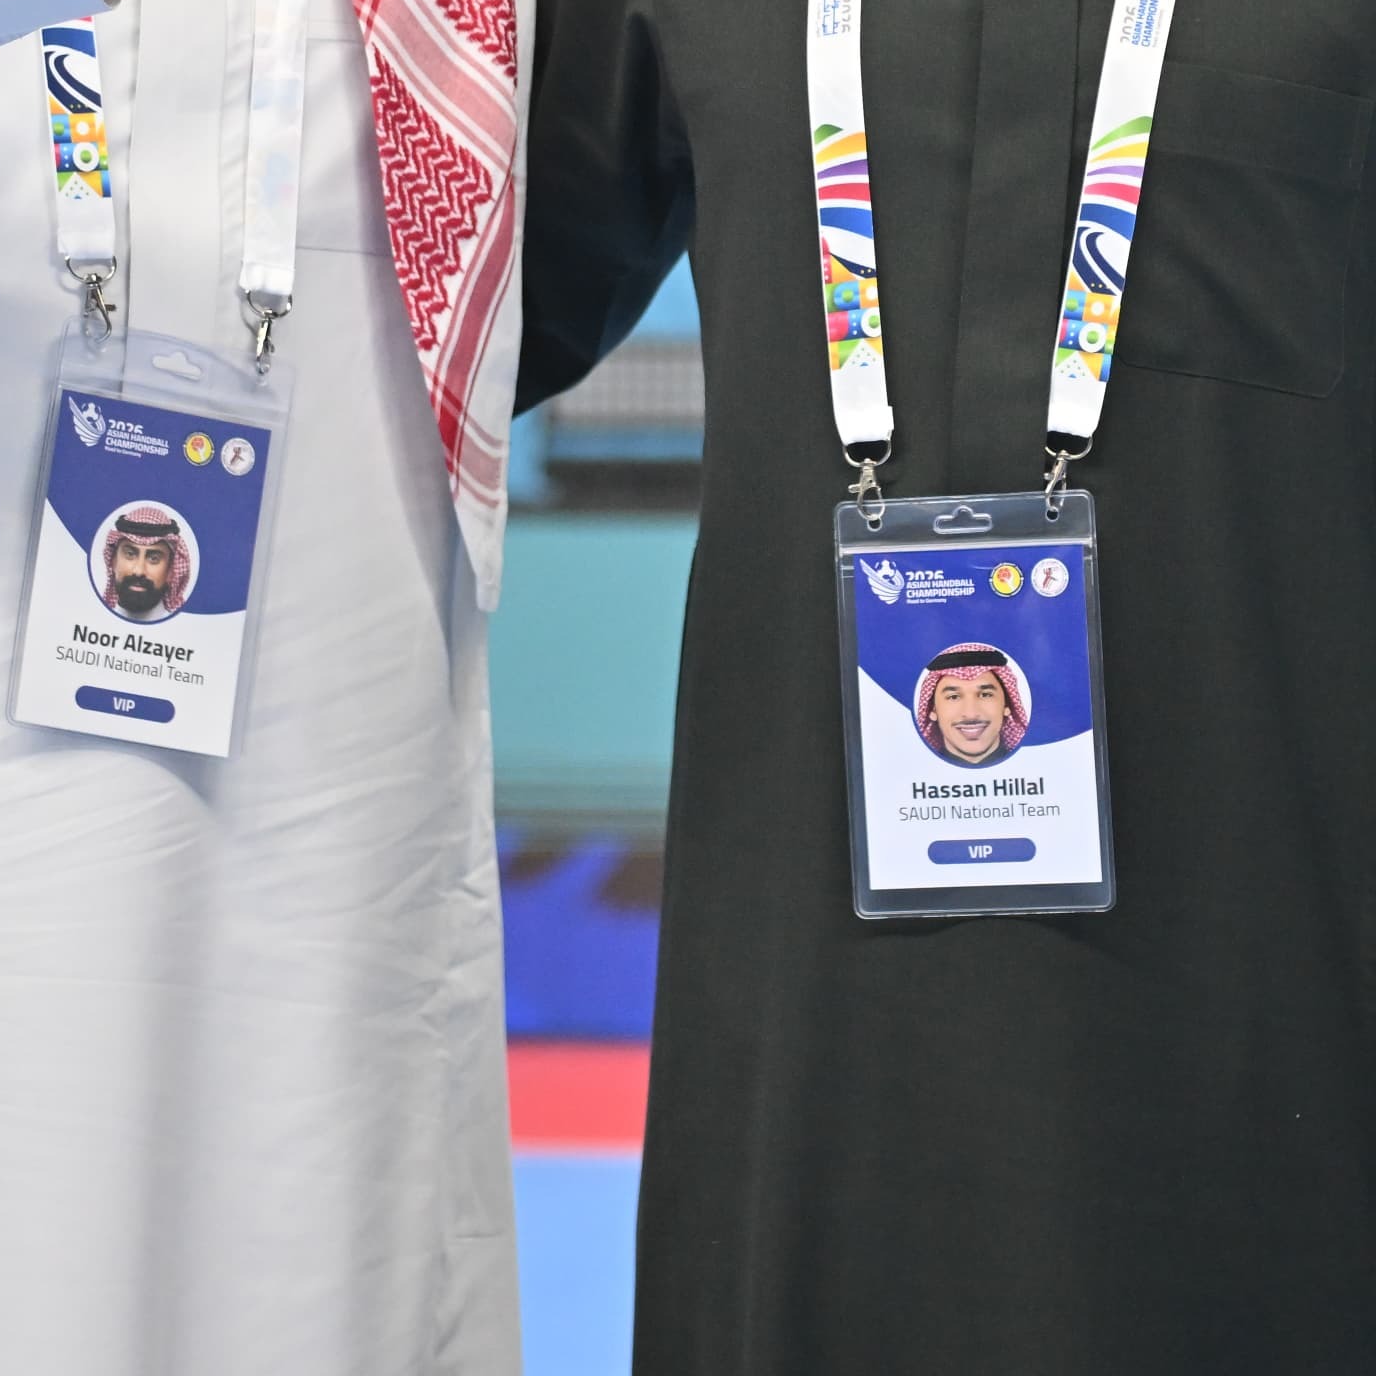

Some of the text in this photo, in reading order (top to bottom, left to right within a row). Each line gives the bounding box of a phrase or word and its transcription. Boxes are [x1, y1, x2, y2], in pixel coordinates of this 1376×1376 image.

[1131, 22, 1143, 46] ASIAN
[108, 418, 144, 434] 2026
[105, 437, 169, 456] CHAMPIONSHIP
[106, 429, 169, 448] ASIAN HANDBALL
[905, 569, 944, 581] 2026
[906, 578, 975, 589] ASIAN HANDBALL
[906, 587, 975, 598] CHAMPIONSHIP
[73, 624, 194, 663] Noor Alzayer
[56, 645, 205, 685] SAUDI National Team
[112, 696, 136, 712] VIP
[912, 777, 1045, 800] Hassan Hillal
[898, 802, 1061, 822] SAUDI National Team
[968, 845, 993, 860] VIP
